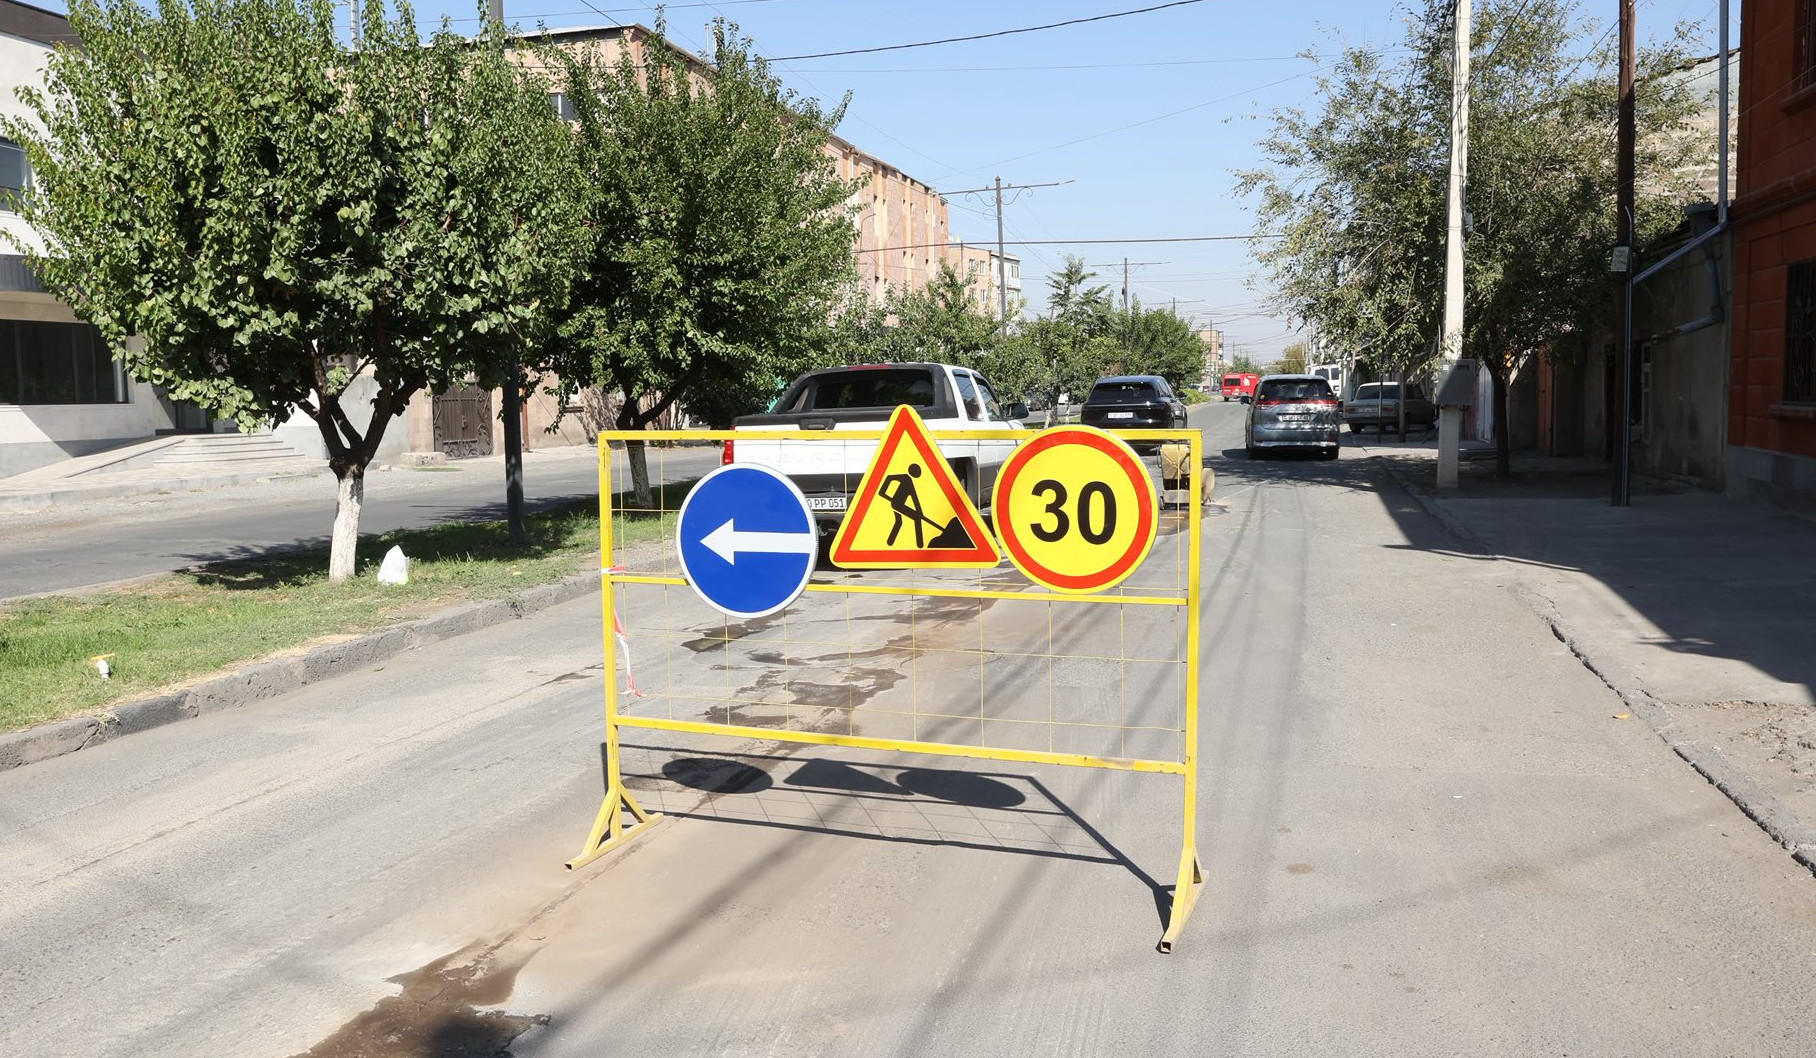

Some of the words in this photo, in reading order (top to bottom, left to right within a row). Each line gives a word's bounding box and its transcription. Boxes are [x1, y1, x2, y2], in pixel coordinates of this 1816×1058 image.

[814, 498, 827, 508] PP
[828, 498, 845, 508] 051
[1030, 479, 1117, 545] 30
